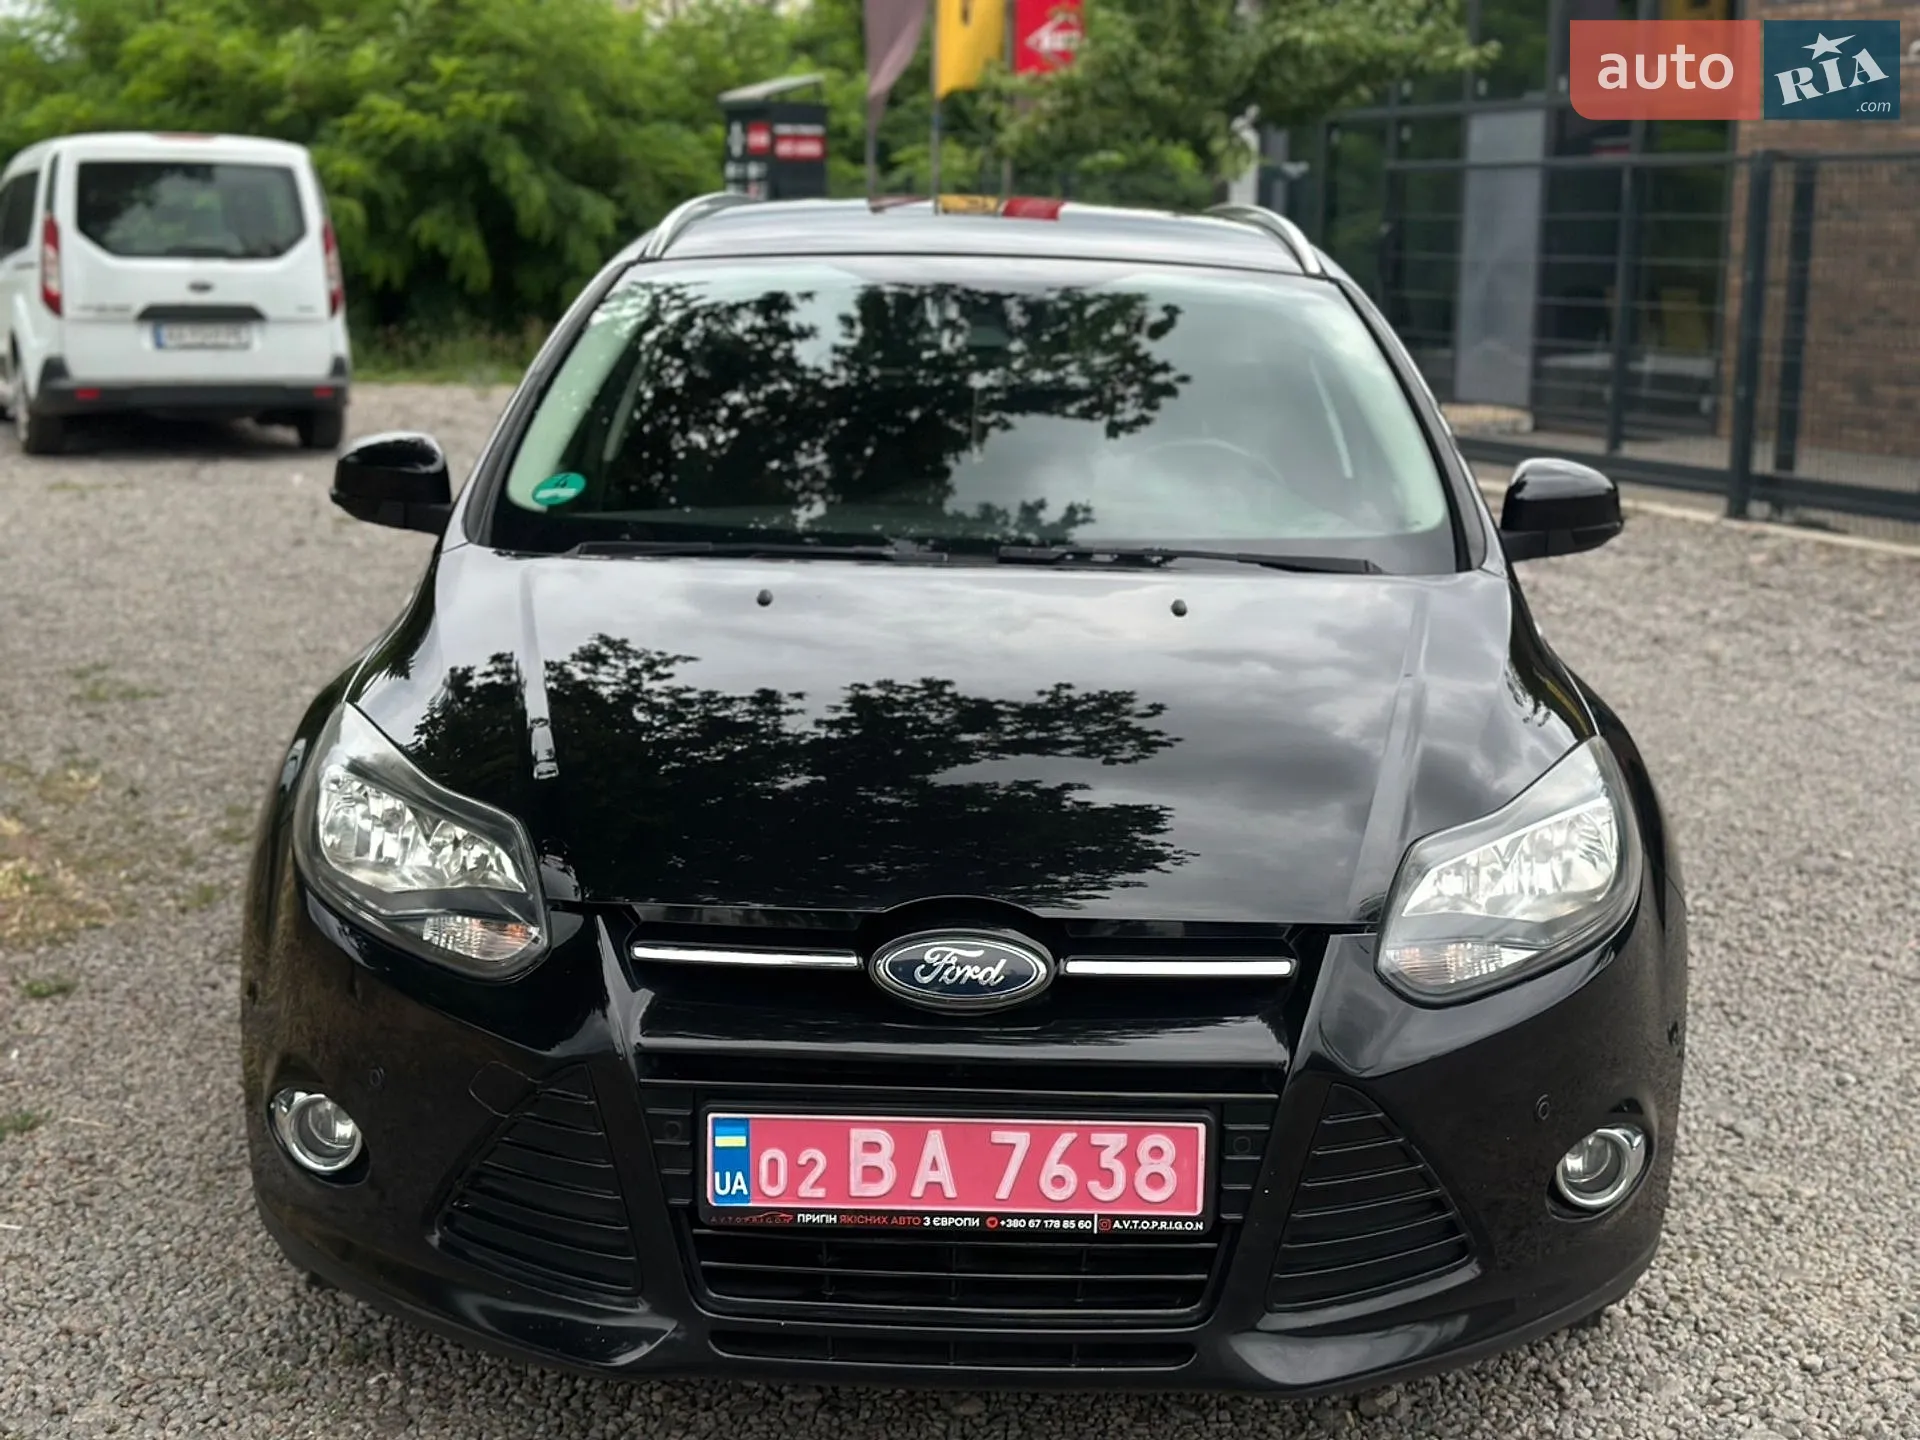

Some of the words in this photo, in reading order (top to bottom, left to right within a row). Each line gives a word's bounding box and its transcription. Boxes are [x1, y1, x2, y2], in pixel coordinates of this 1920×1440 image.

[914, 947, 1007, 987] Ford
[758, 1147, 828, 1198] 02
[849, 1128, 958, 1199] BA
[990, 1130, 1178, 1203] 7638
[714, 1171, 748, 1196] UA
[890, 1215, 921, 1226] АВТО
[932, 1216, 980, 1227] ЄВРОПИ
[1000, 1218, 1026, 1228] +380
[1028, 1218, 1041, 1228] 67
[1044, 1219, 1061, 1229] 178
[1077, 1220, 1092, 1230] 60
